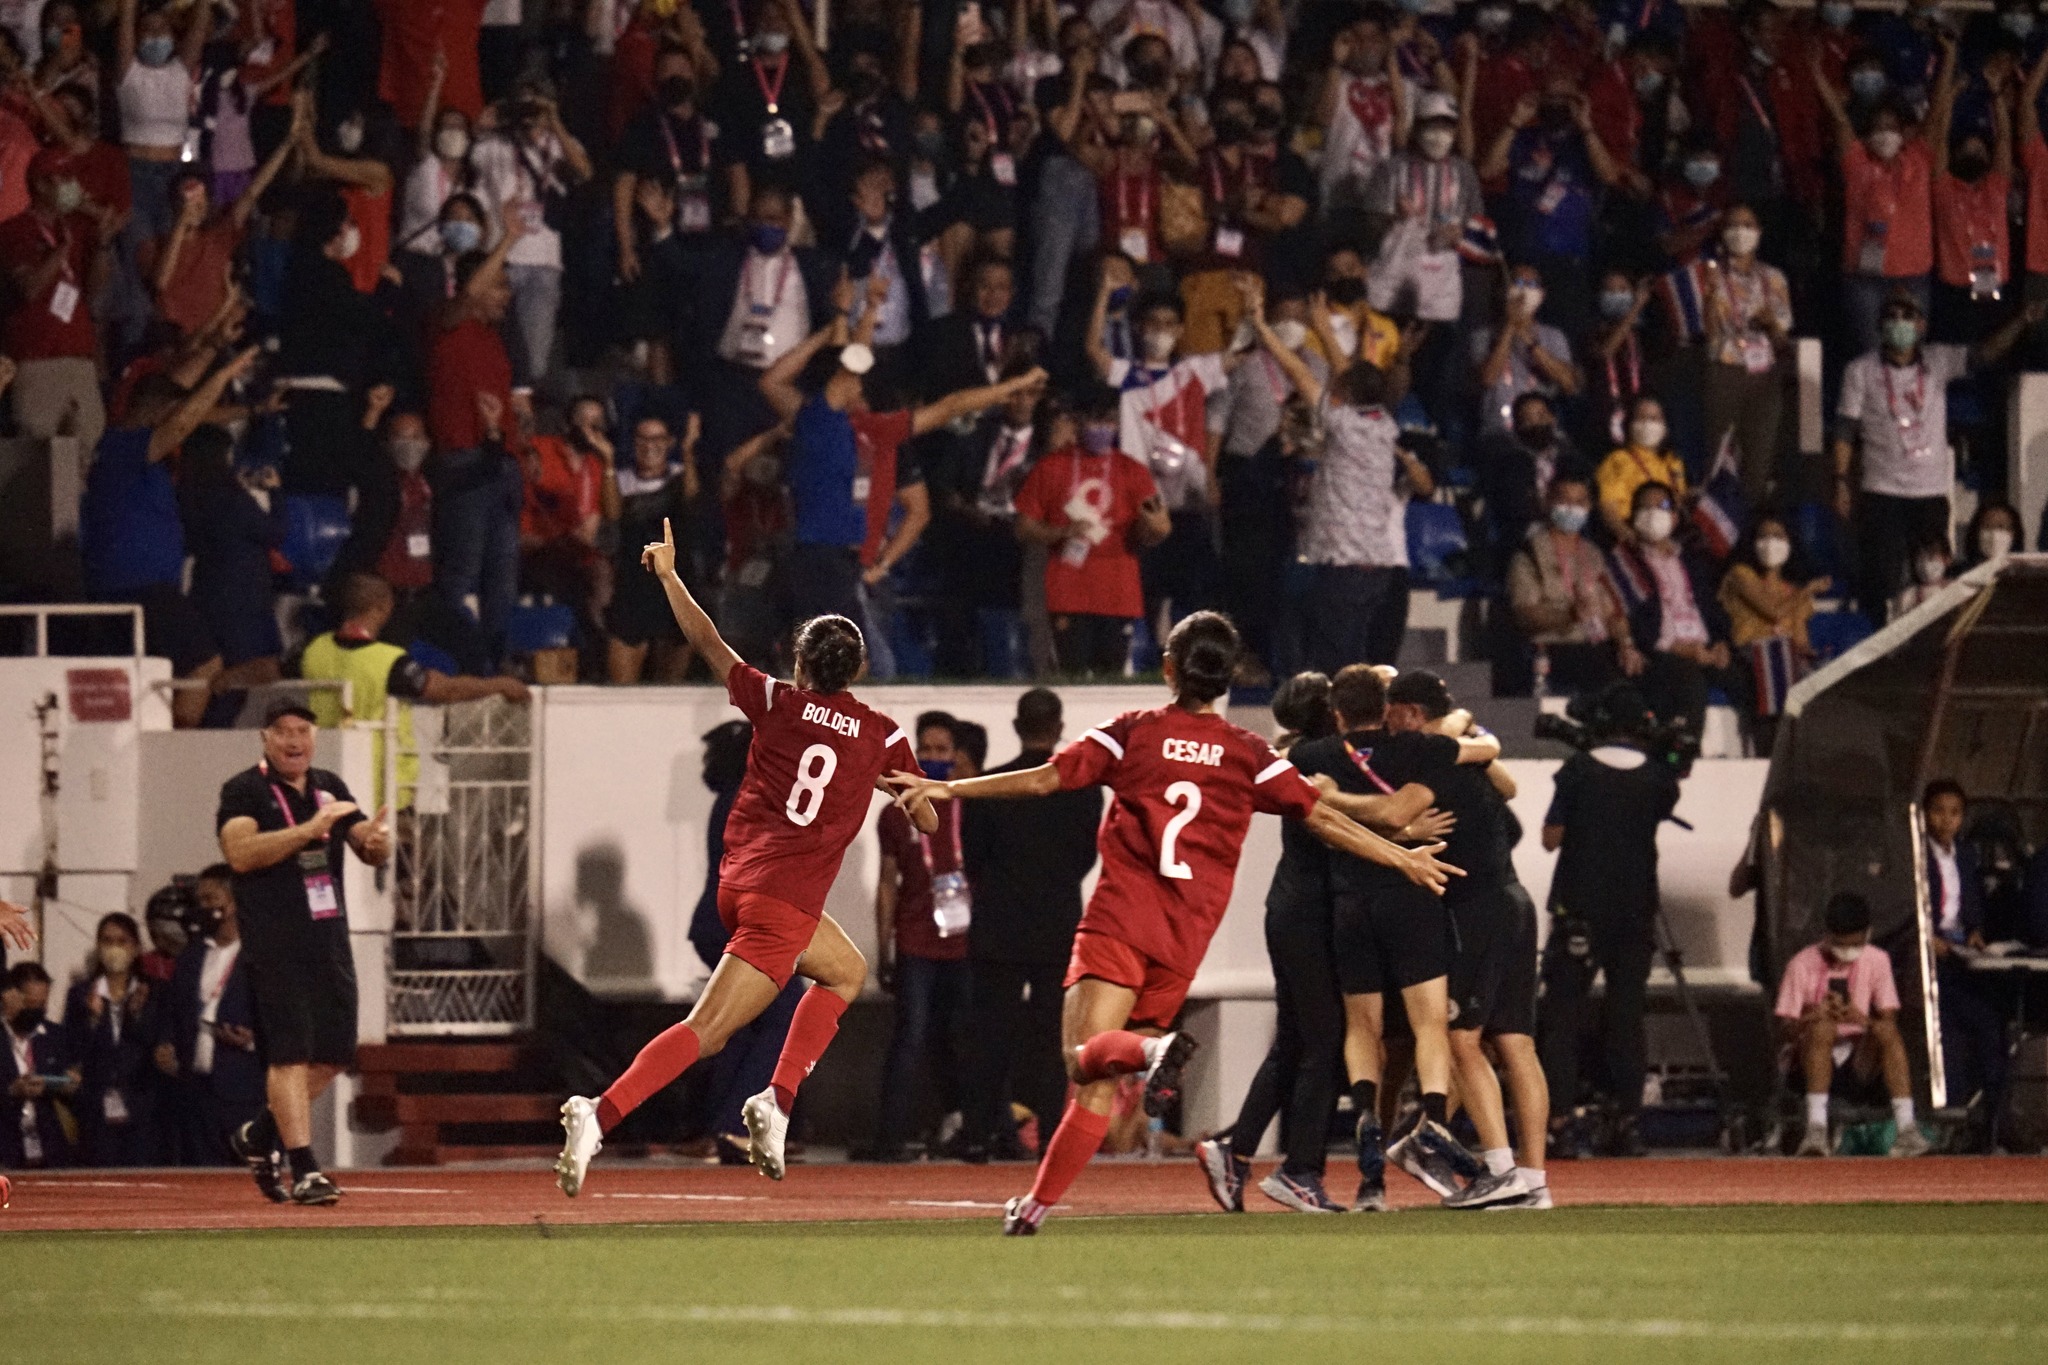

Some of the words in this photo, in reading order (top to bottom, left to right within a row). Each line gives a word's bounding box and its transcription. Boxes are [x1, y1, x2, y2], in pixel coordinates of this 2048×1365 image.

[801, 702, 861, 738] BOLDEN
[1162, 737, 1225, 767] CESAR
[785, 743, 838, 827] 8
[1159, 780, 1202, 880] 2
